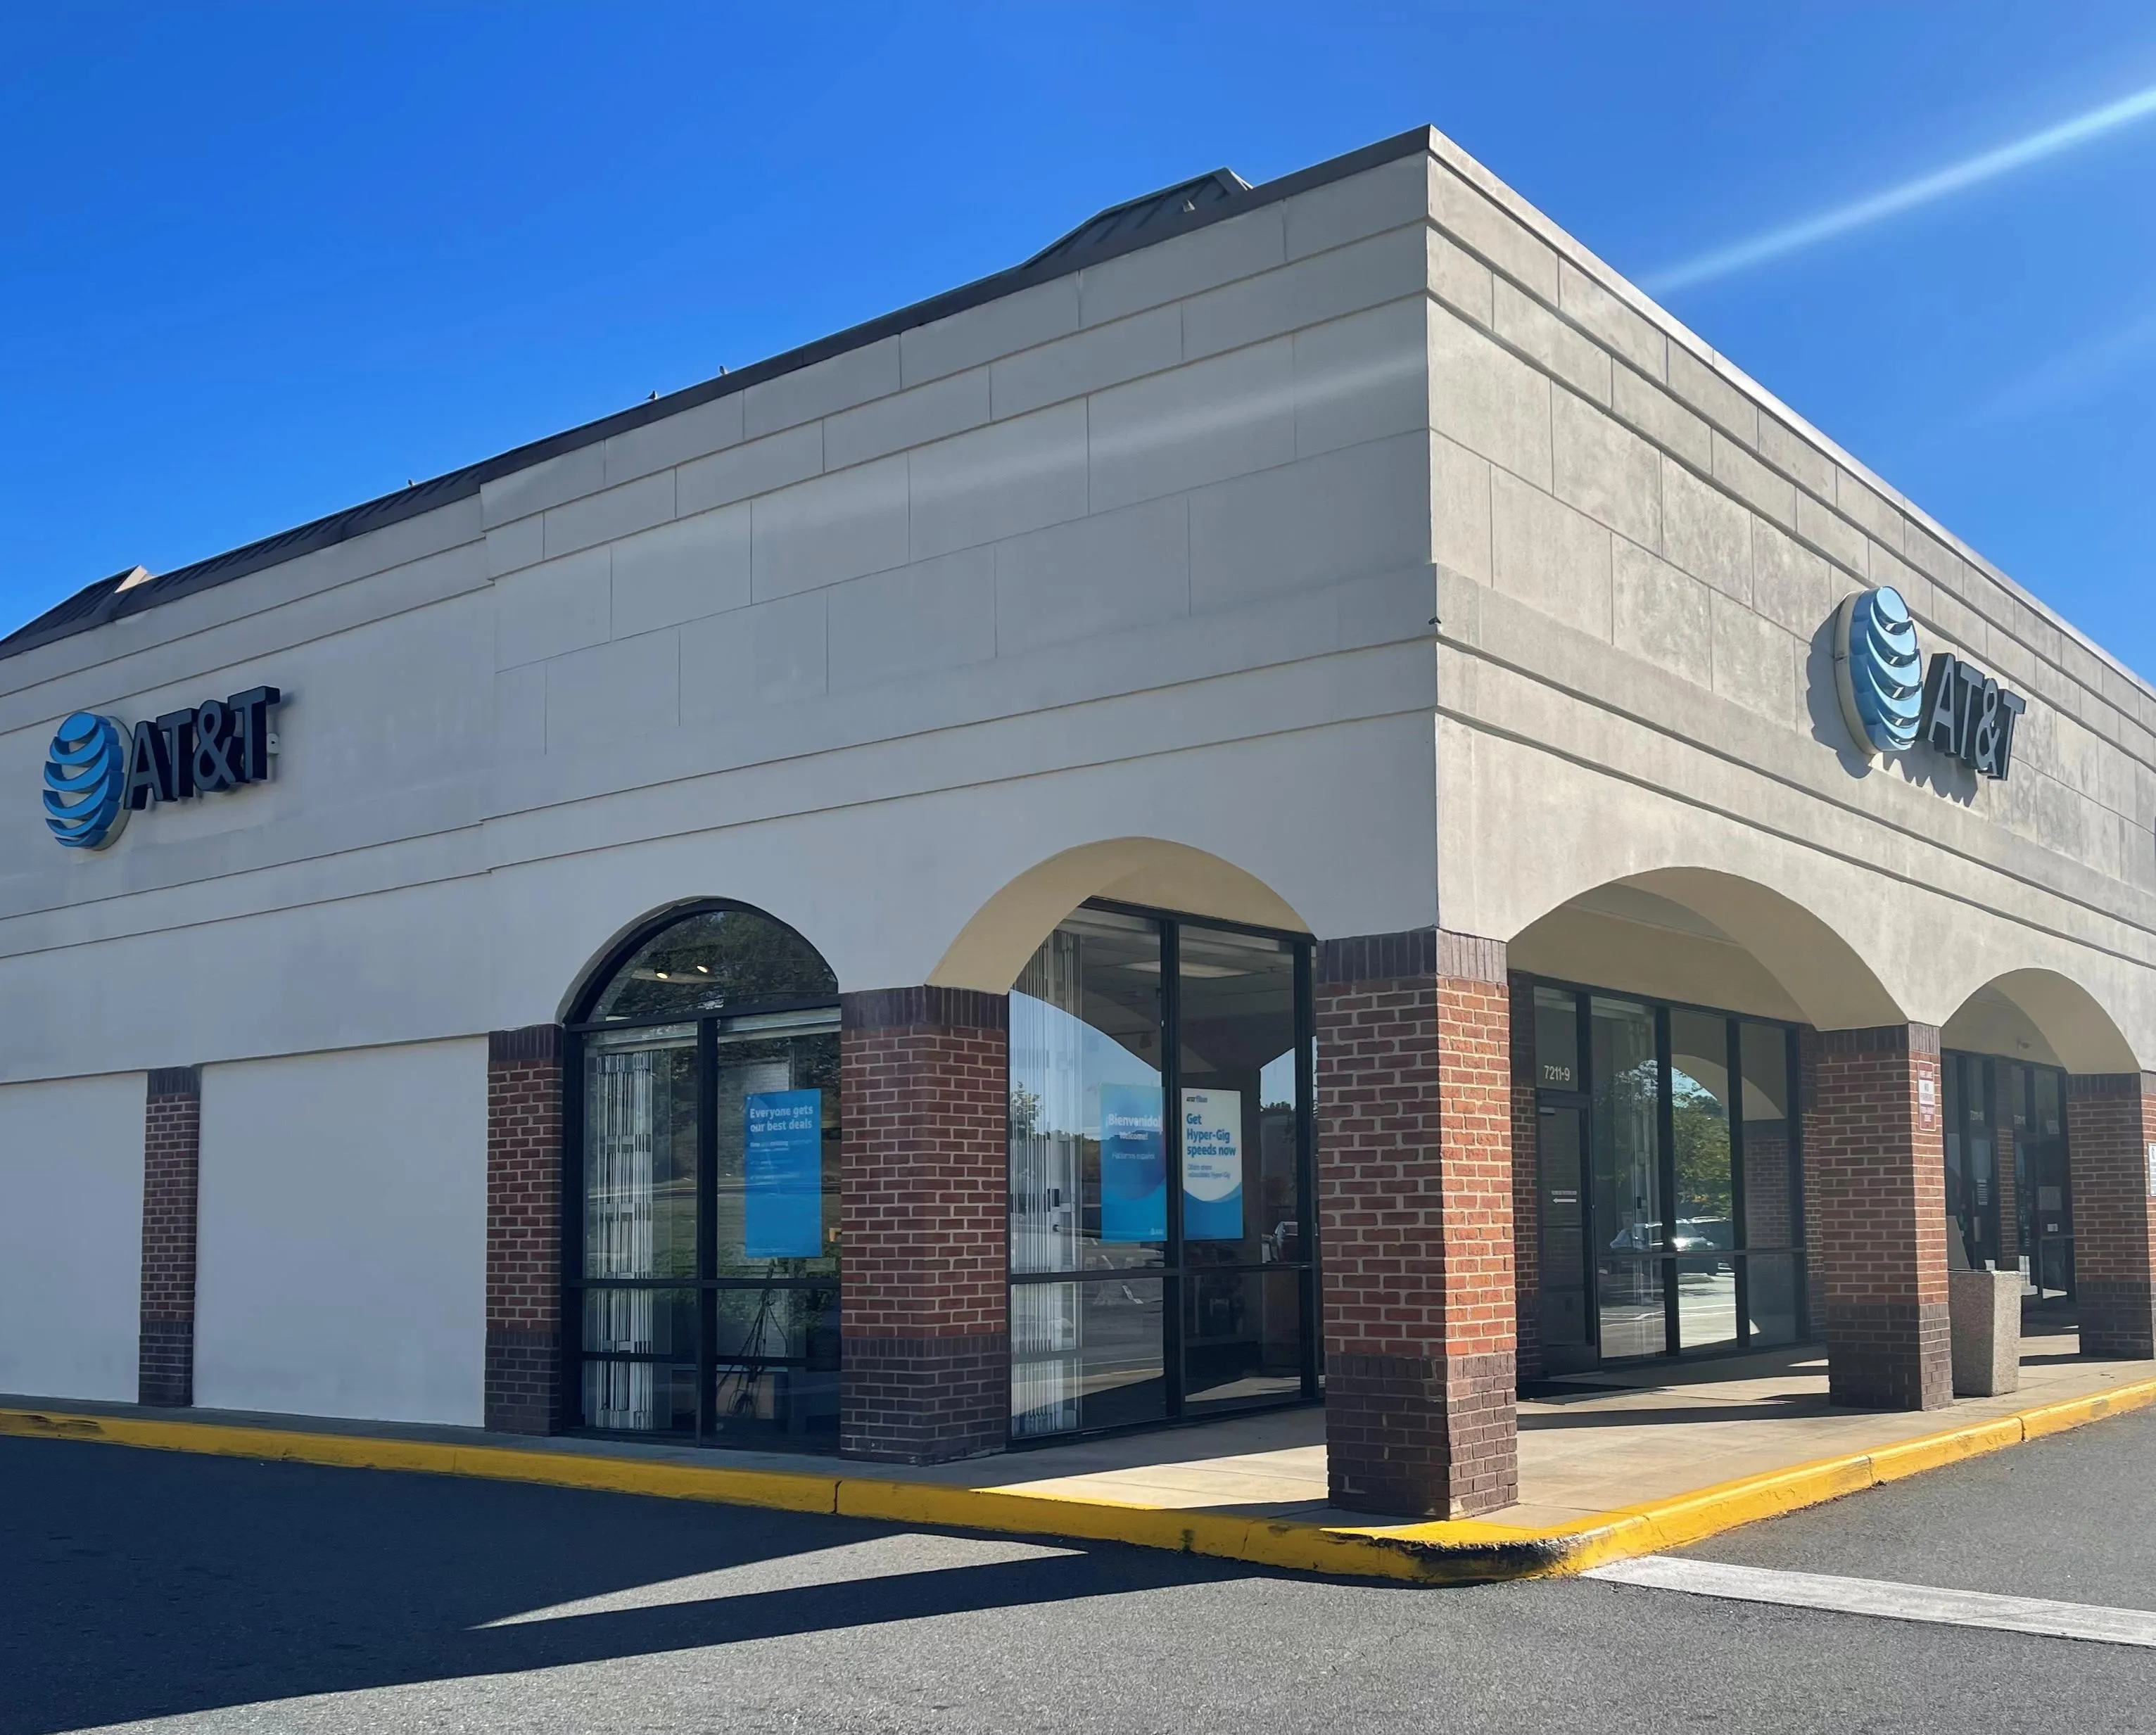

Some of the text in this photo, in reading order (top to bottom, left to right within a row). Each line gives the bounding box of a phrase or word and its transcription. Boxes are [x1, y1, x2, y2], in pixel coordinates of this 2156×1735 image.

[1917, 652, 2027, 782] AT&T
[123, 685, 280, 811] AT&T
[1544, 1065, 1571, 1081] 7211-9
[749, 1105, 813, 1119] Everyone gets
[1186, 1113, 1202, 1125] Get
[749, 1118, 813, 1132] our best deals
[1186, 1128, 1231, 1143] Hyper-Gig
[1187, 1144, 1236, 1157] speeds now
